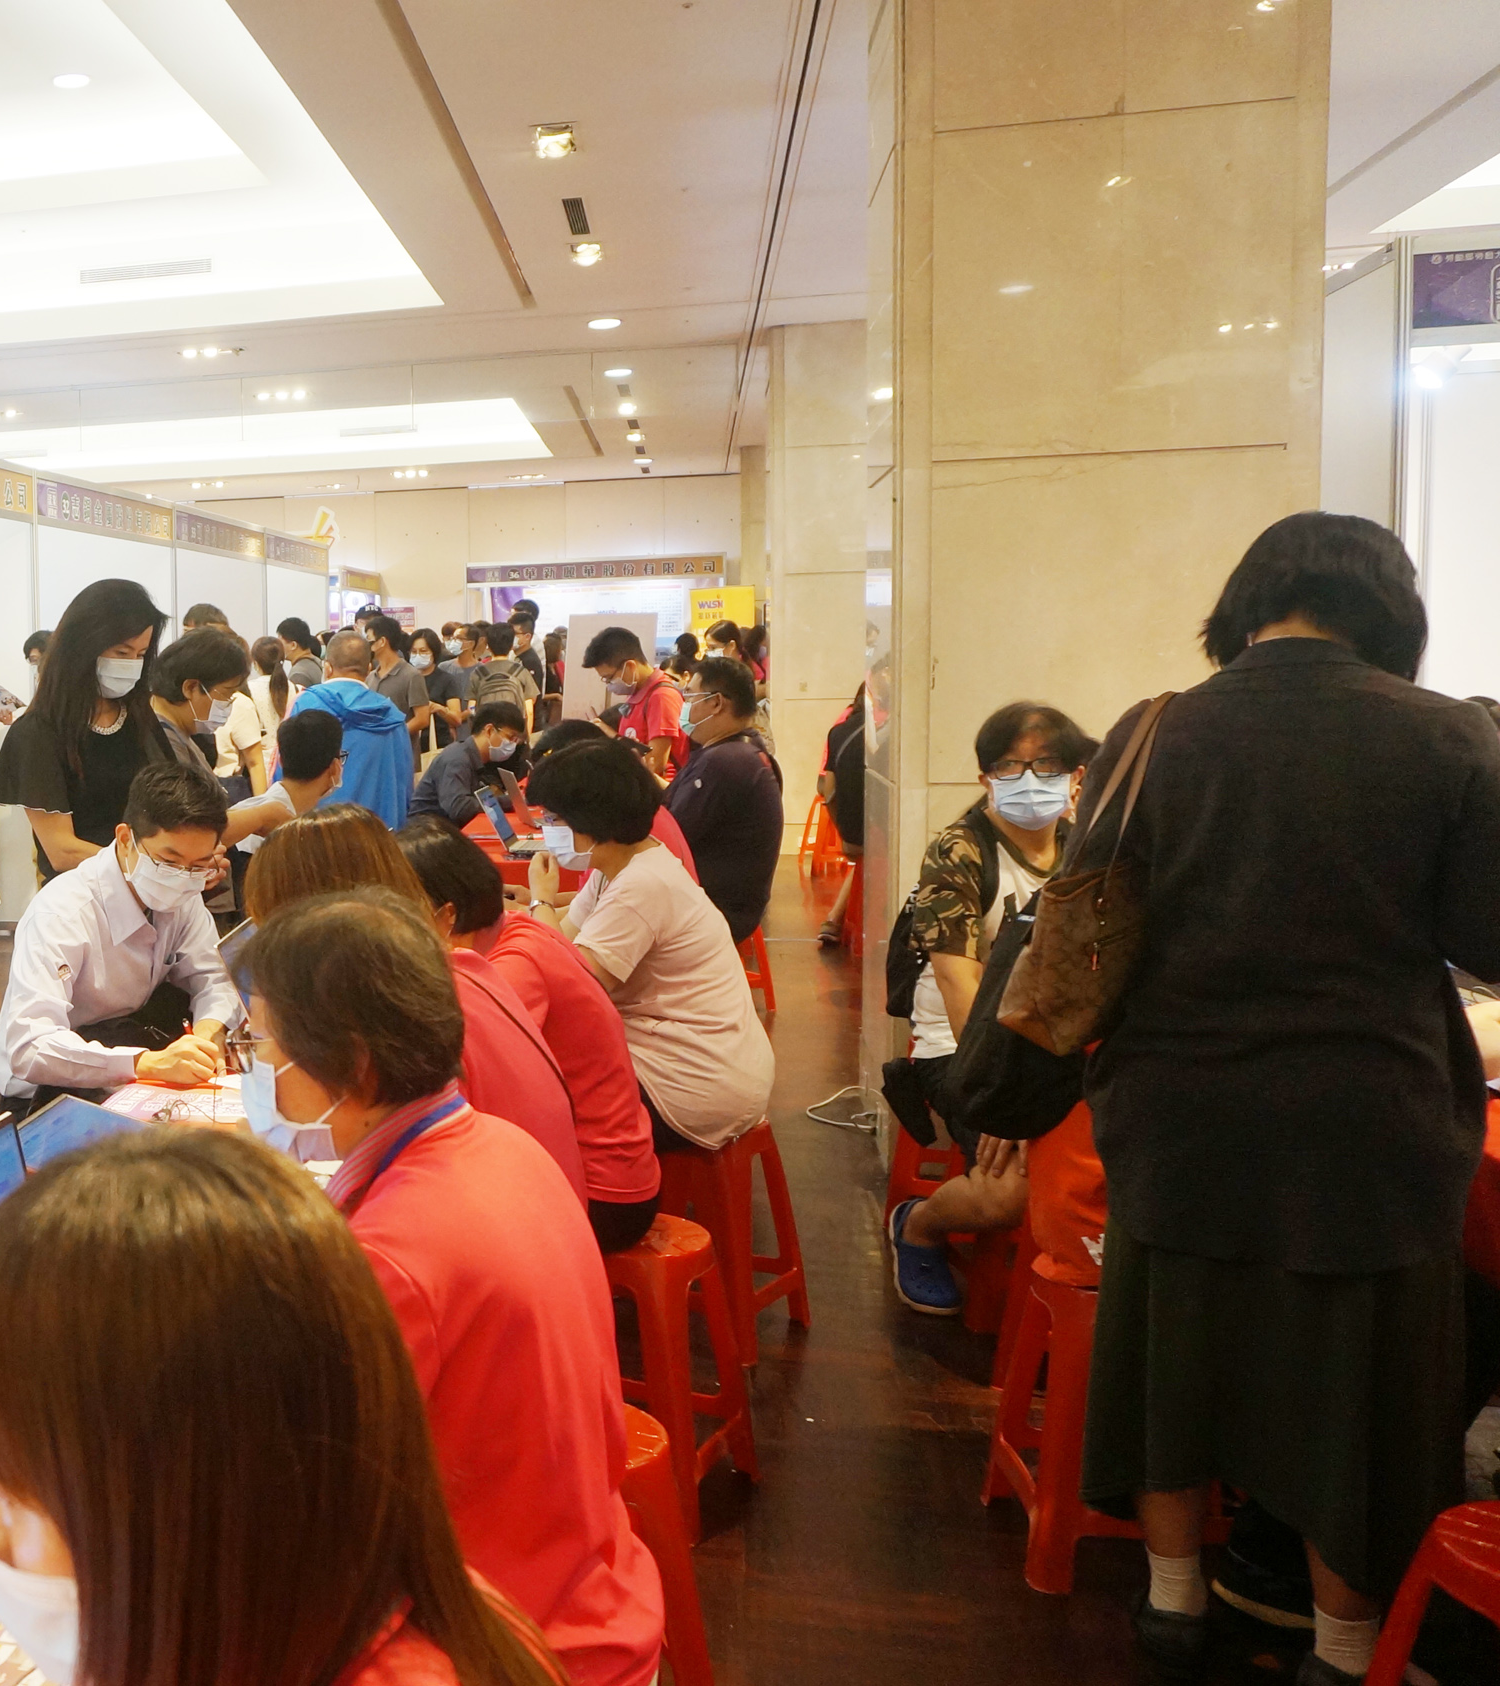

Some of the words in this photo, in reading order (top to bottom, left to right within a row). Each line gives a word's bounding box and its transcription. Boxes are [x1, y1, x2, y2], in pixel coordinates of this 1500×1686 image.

[508, 571, 520, 579] 36
[523, 560, 716, 579] 華新麗華股份有限公司
